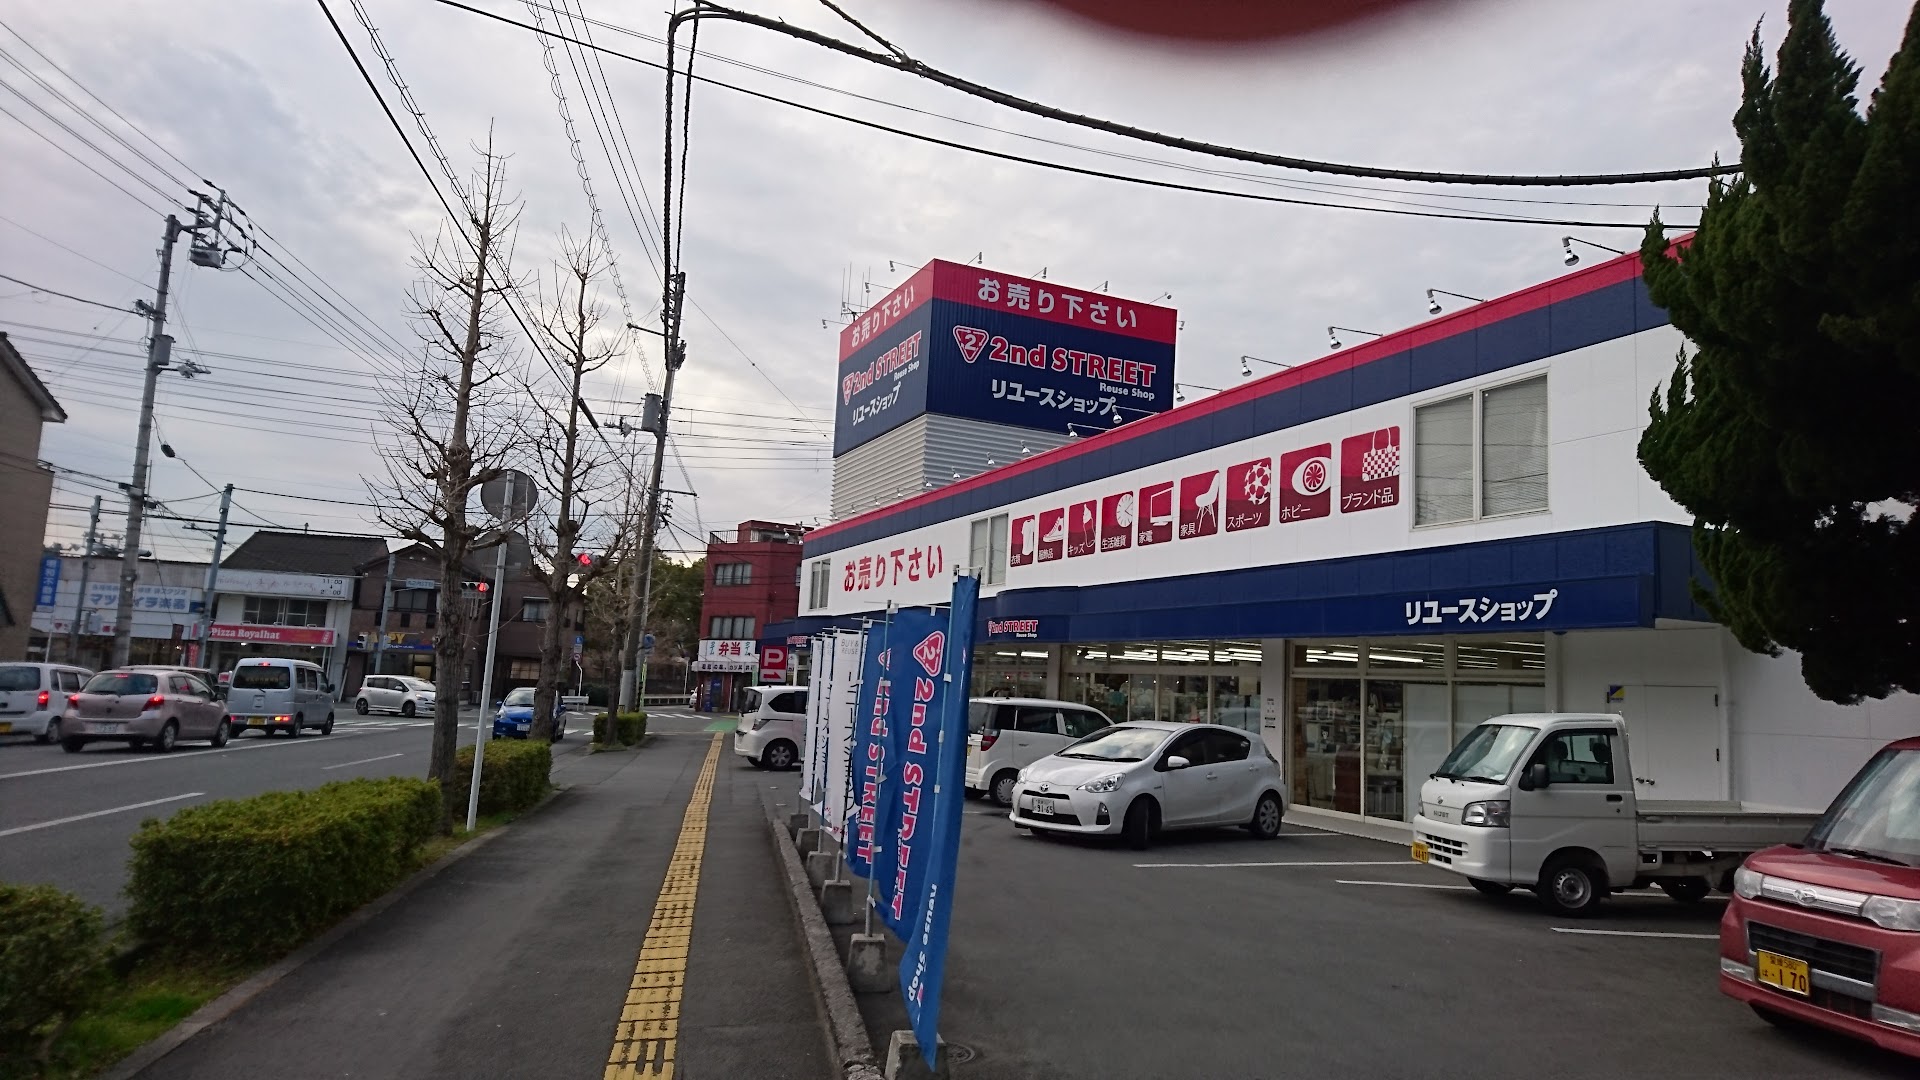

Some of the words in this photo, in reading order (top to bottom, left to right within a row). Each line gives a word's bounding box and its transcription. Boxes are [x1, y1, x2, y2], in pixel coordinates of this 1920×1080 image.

[978, 277, 1137, 328] お売り下さい
[851, 285, 915, 348] お売り下さい
[853, 361, 874, 395] 2nd
[875, 330, 922, 381] STREET
[989, 336, 1047, 369] 2nd
[1051, 347, 1157, 387] STREET
[991, 378, 1116, 416] リユースショップ
[1100, 382, 1129, 396] Reuse
[1131, 387, 1155, 401] Shop
[853, 381, 902, 427] リユースショップ
[1342, 486, 1394, 510] ブランド品
[1227, 512, 1262, 529] スポーツ
[1281, 503, 1311, 521] ホビー
[1180, 522, 1196, 537] 家具
[1067, 543, 1085, 554] キッズ
[1101, 534, 1127, 549] 生活雑貨
[844, 544, 943, 592] お売り下さい
[1405, 588, 1558, 626] リユースショップ
[210, 627, 235, 637] Pizza
[1004, 620, 1038, 632] STREET
[719, 641, 741, 656] 弁当
[764, 649, 784, 667] P
[907, 676, 935, 754] 2nd
